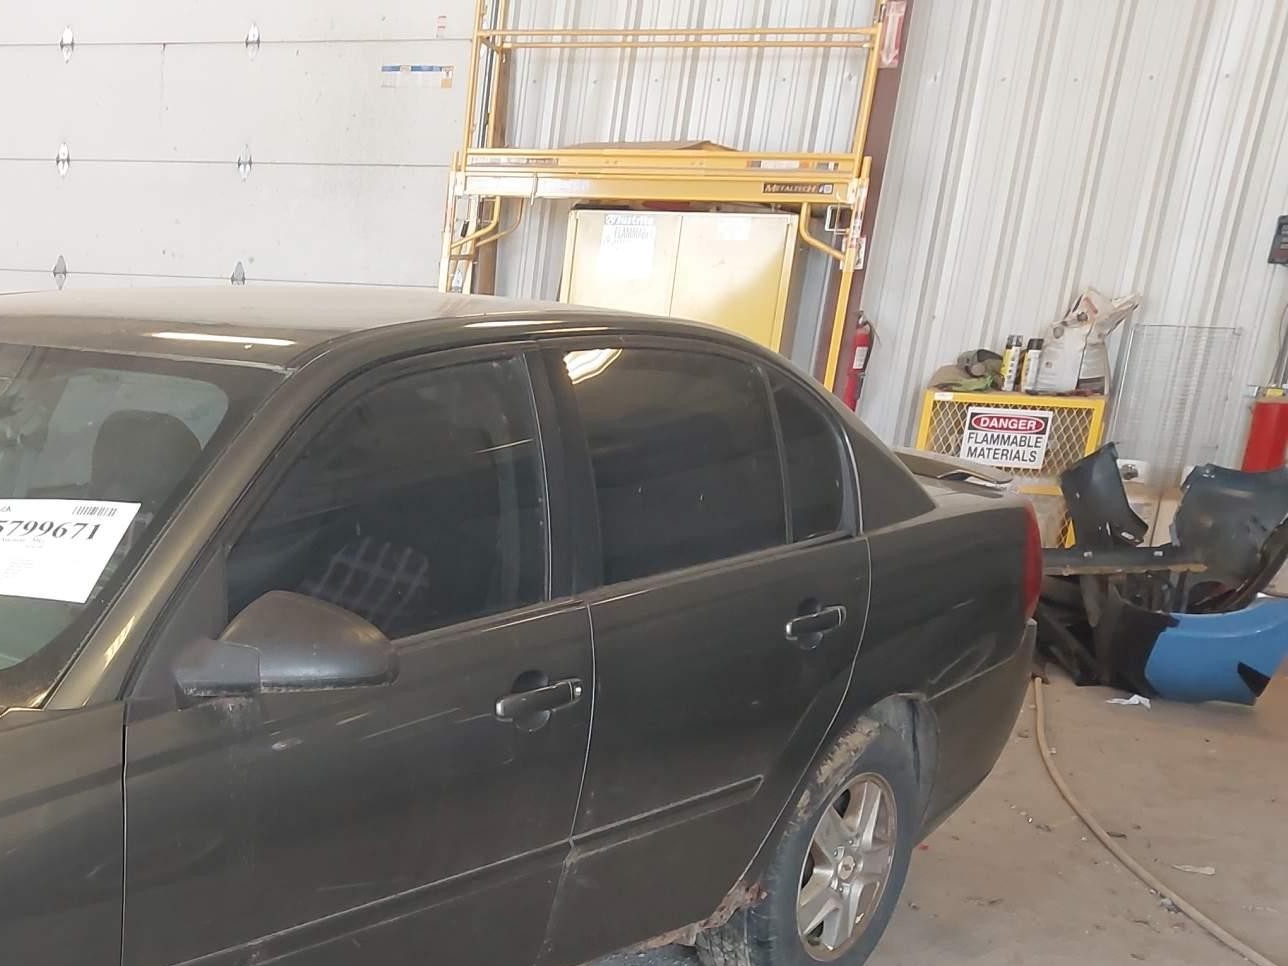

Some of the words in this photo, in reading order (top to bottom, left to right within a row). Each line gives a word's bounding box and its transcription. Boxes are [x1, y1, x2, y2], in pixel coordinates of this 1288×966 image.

[980, 417, 1037, 431] DANGER
[966, 431, 1044, 449] FLAMMABLE
[966, 446, 1037, 463] MATERIALS
